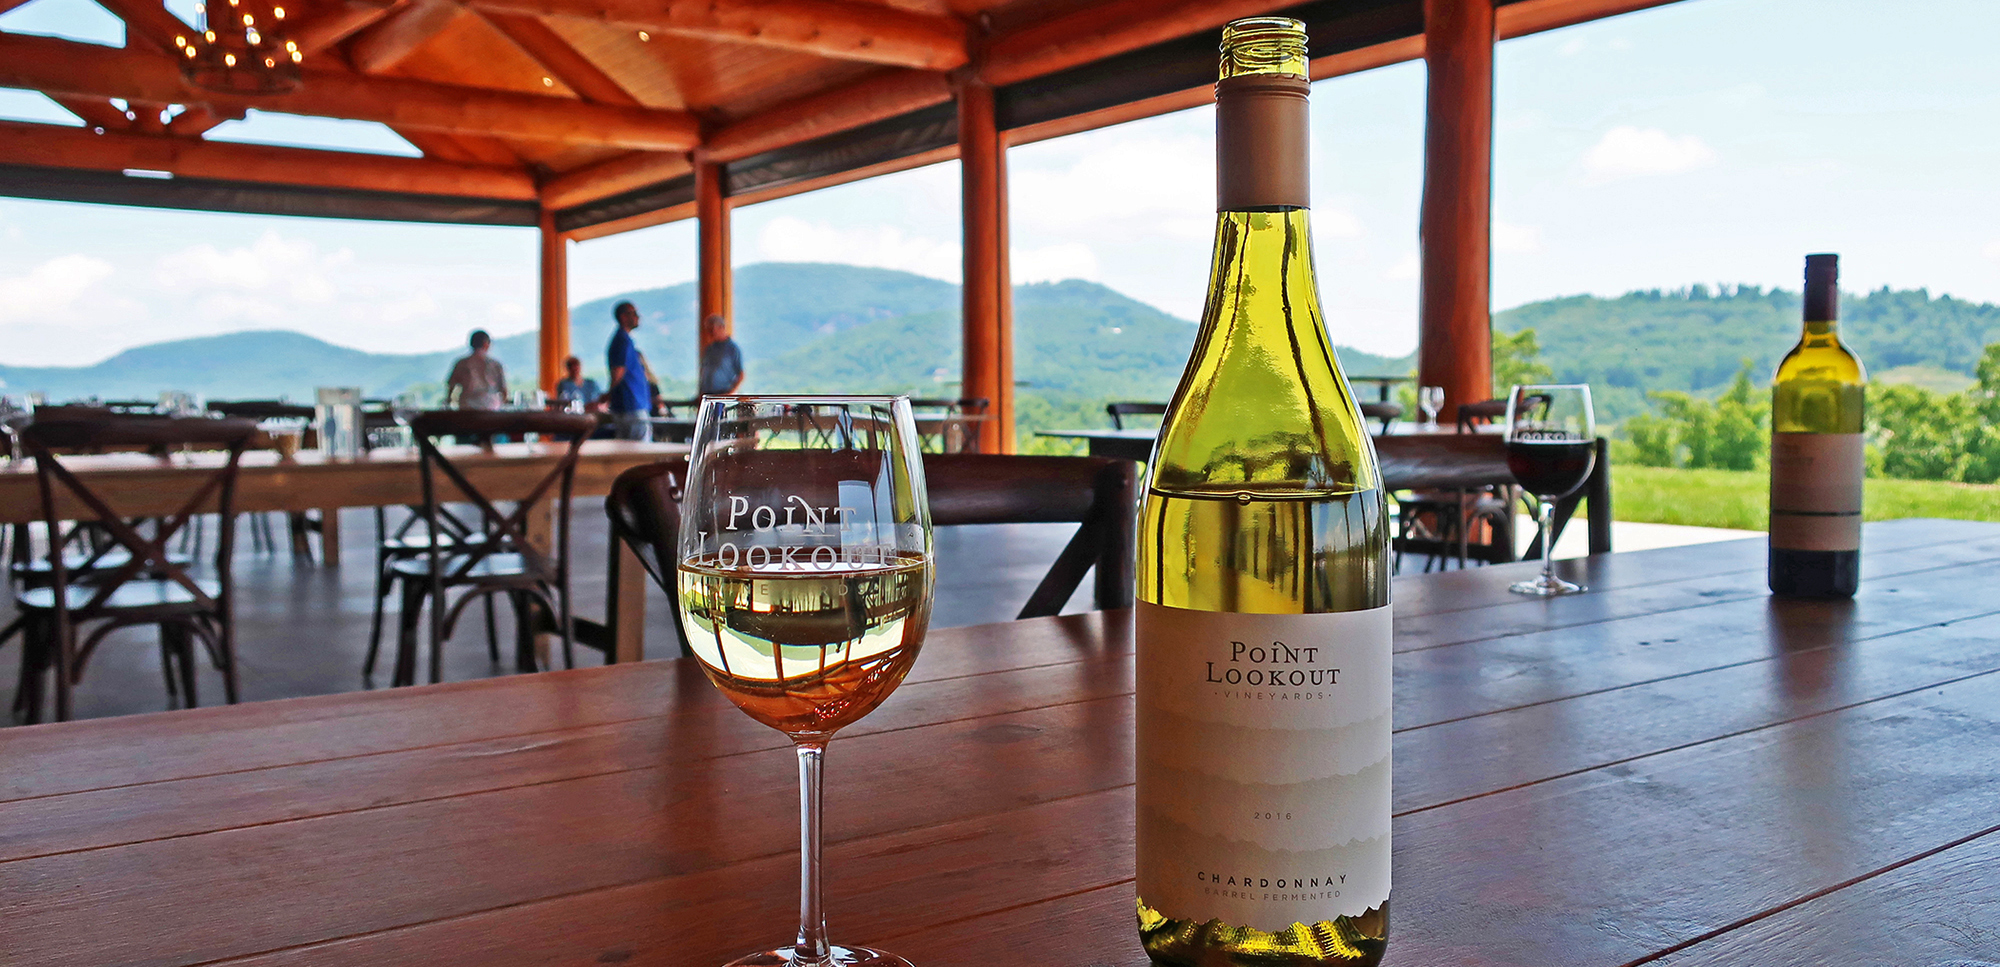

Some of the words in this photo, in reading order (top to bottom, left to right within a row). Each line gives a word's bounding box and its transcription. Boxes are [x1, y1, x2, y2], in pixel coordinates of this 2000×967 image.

[726, 495, 856, 533] POINT
[695, 531, 896, 571] LOOKOUT
[1230, 641, 1319, 664] POINT
[1206, 662, 1341, 686] LOOKOUT
[1254, 812, 1292, 820] 2016
[1197, 871, 1348, 889] CHARDONNAY
[1204, 887, 1255, 900] BARREL
[1263, 890, 1341, 901] FERMENTED
